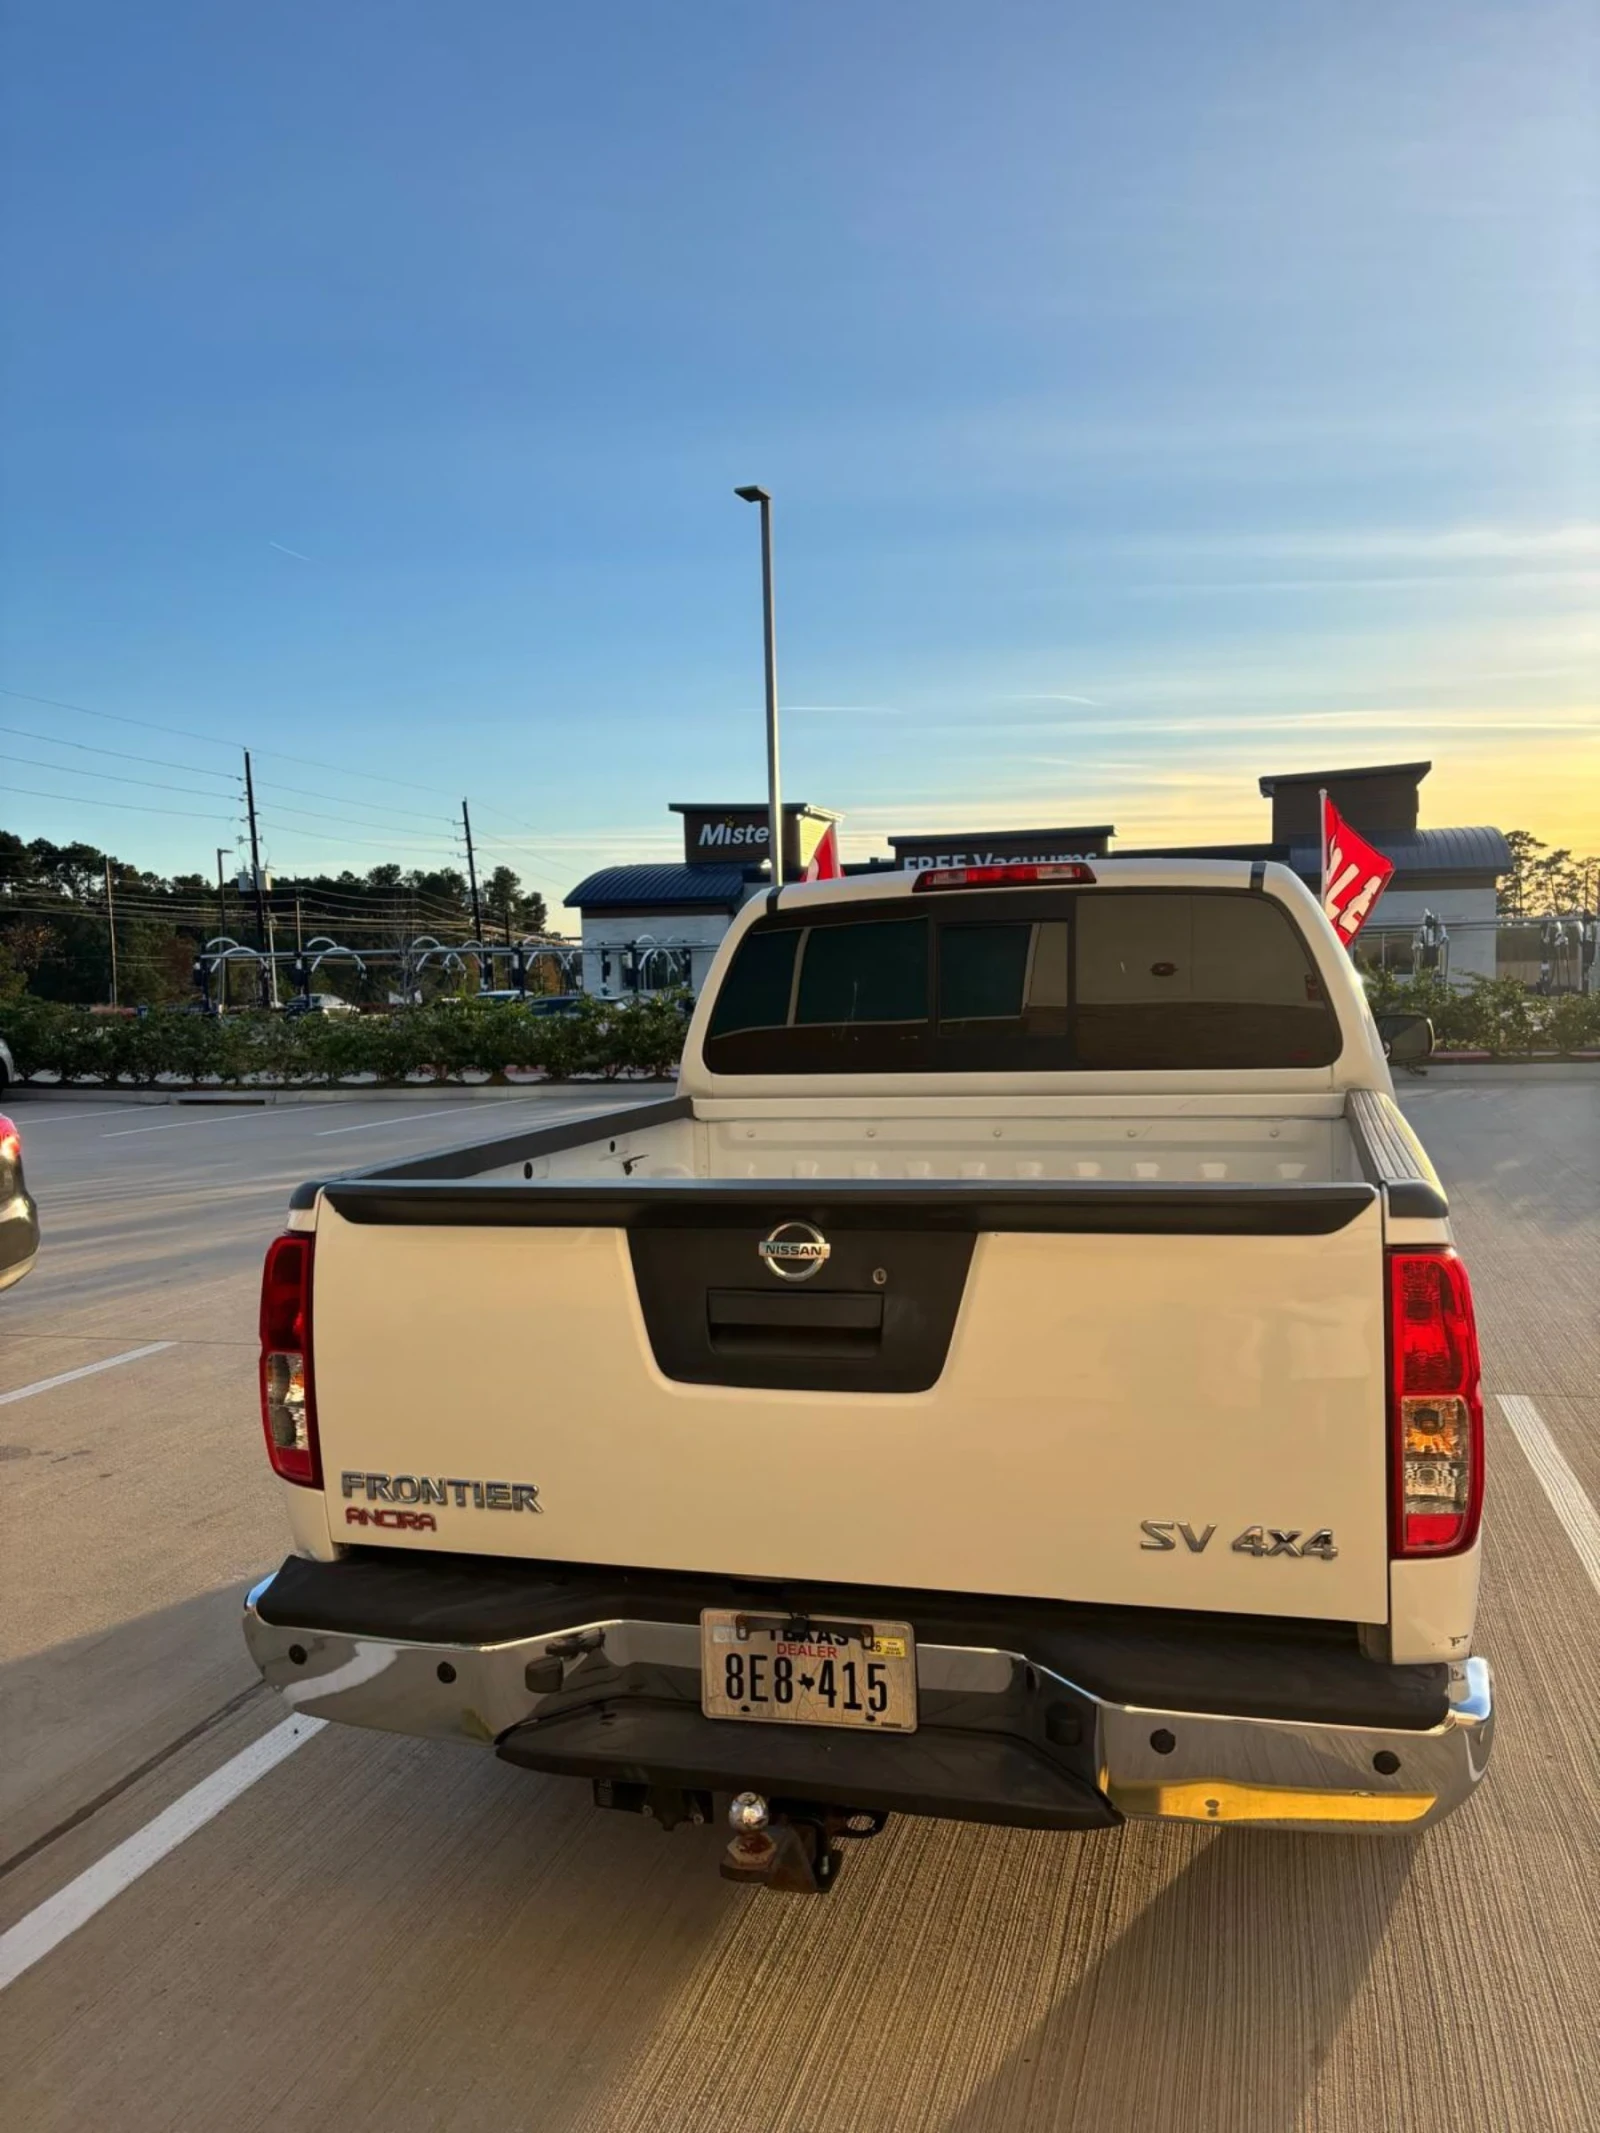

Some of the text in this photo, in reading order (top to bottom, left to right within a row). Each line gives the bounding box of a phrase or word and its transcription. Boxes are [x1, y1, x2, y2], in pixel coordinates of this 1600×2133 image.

[699, 822, 770, 846] Miste
[903, 854, 967, 871] FREE
[765, 1244, 822, 1256] NISSAN
[341, 1471, 544, 1513] FRONTIER
[1140, 1520, 1217, 1553] SV
[776, 1643, 838, 1659] DEALER
